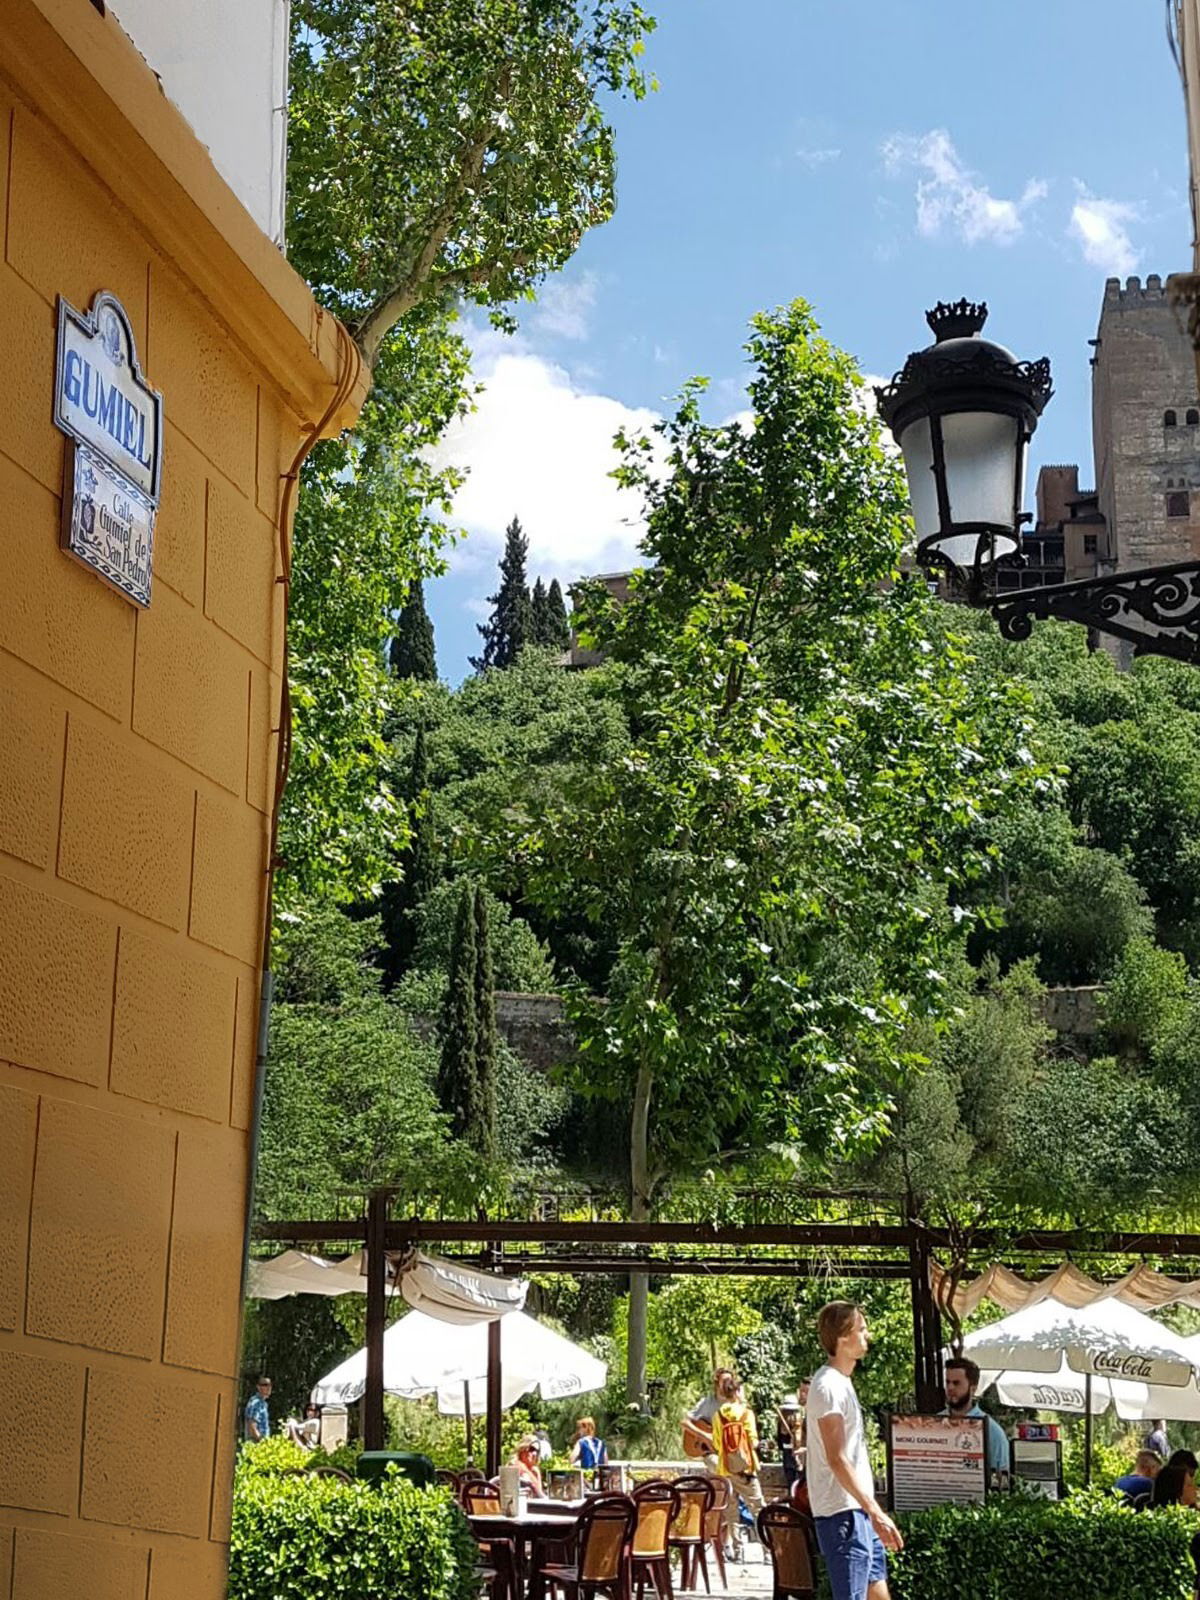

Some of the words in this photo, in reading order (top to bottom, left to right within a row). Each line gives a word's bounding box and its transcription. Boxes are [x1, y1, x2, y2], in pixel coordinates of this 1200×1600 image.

[64, 349, 151, 471] GUMIEL
[100, 504, 132, 549] Gumiel
[135, 533, 147, 560] de
[113, 493, 134, 525] Calle
[103, 534, 122, 567] San
[122, 546, 147, 586] Pedro
